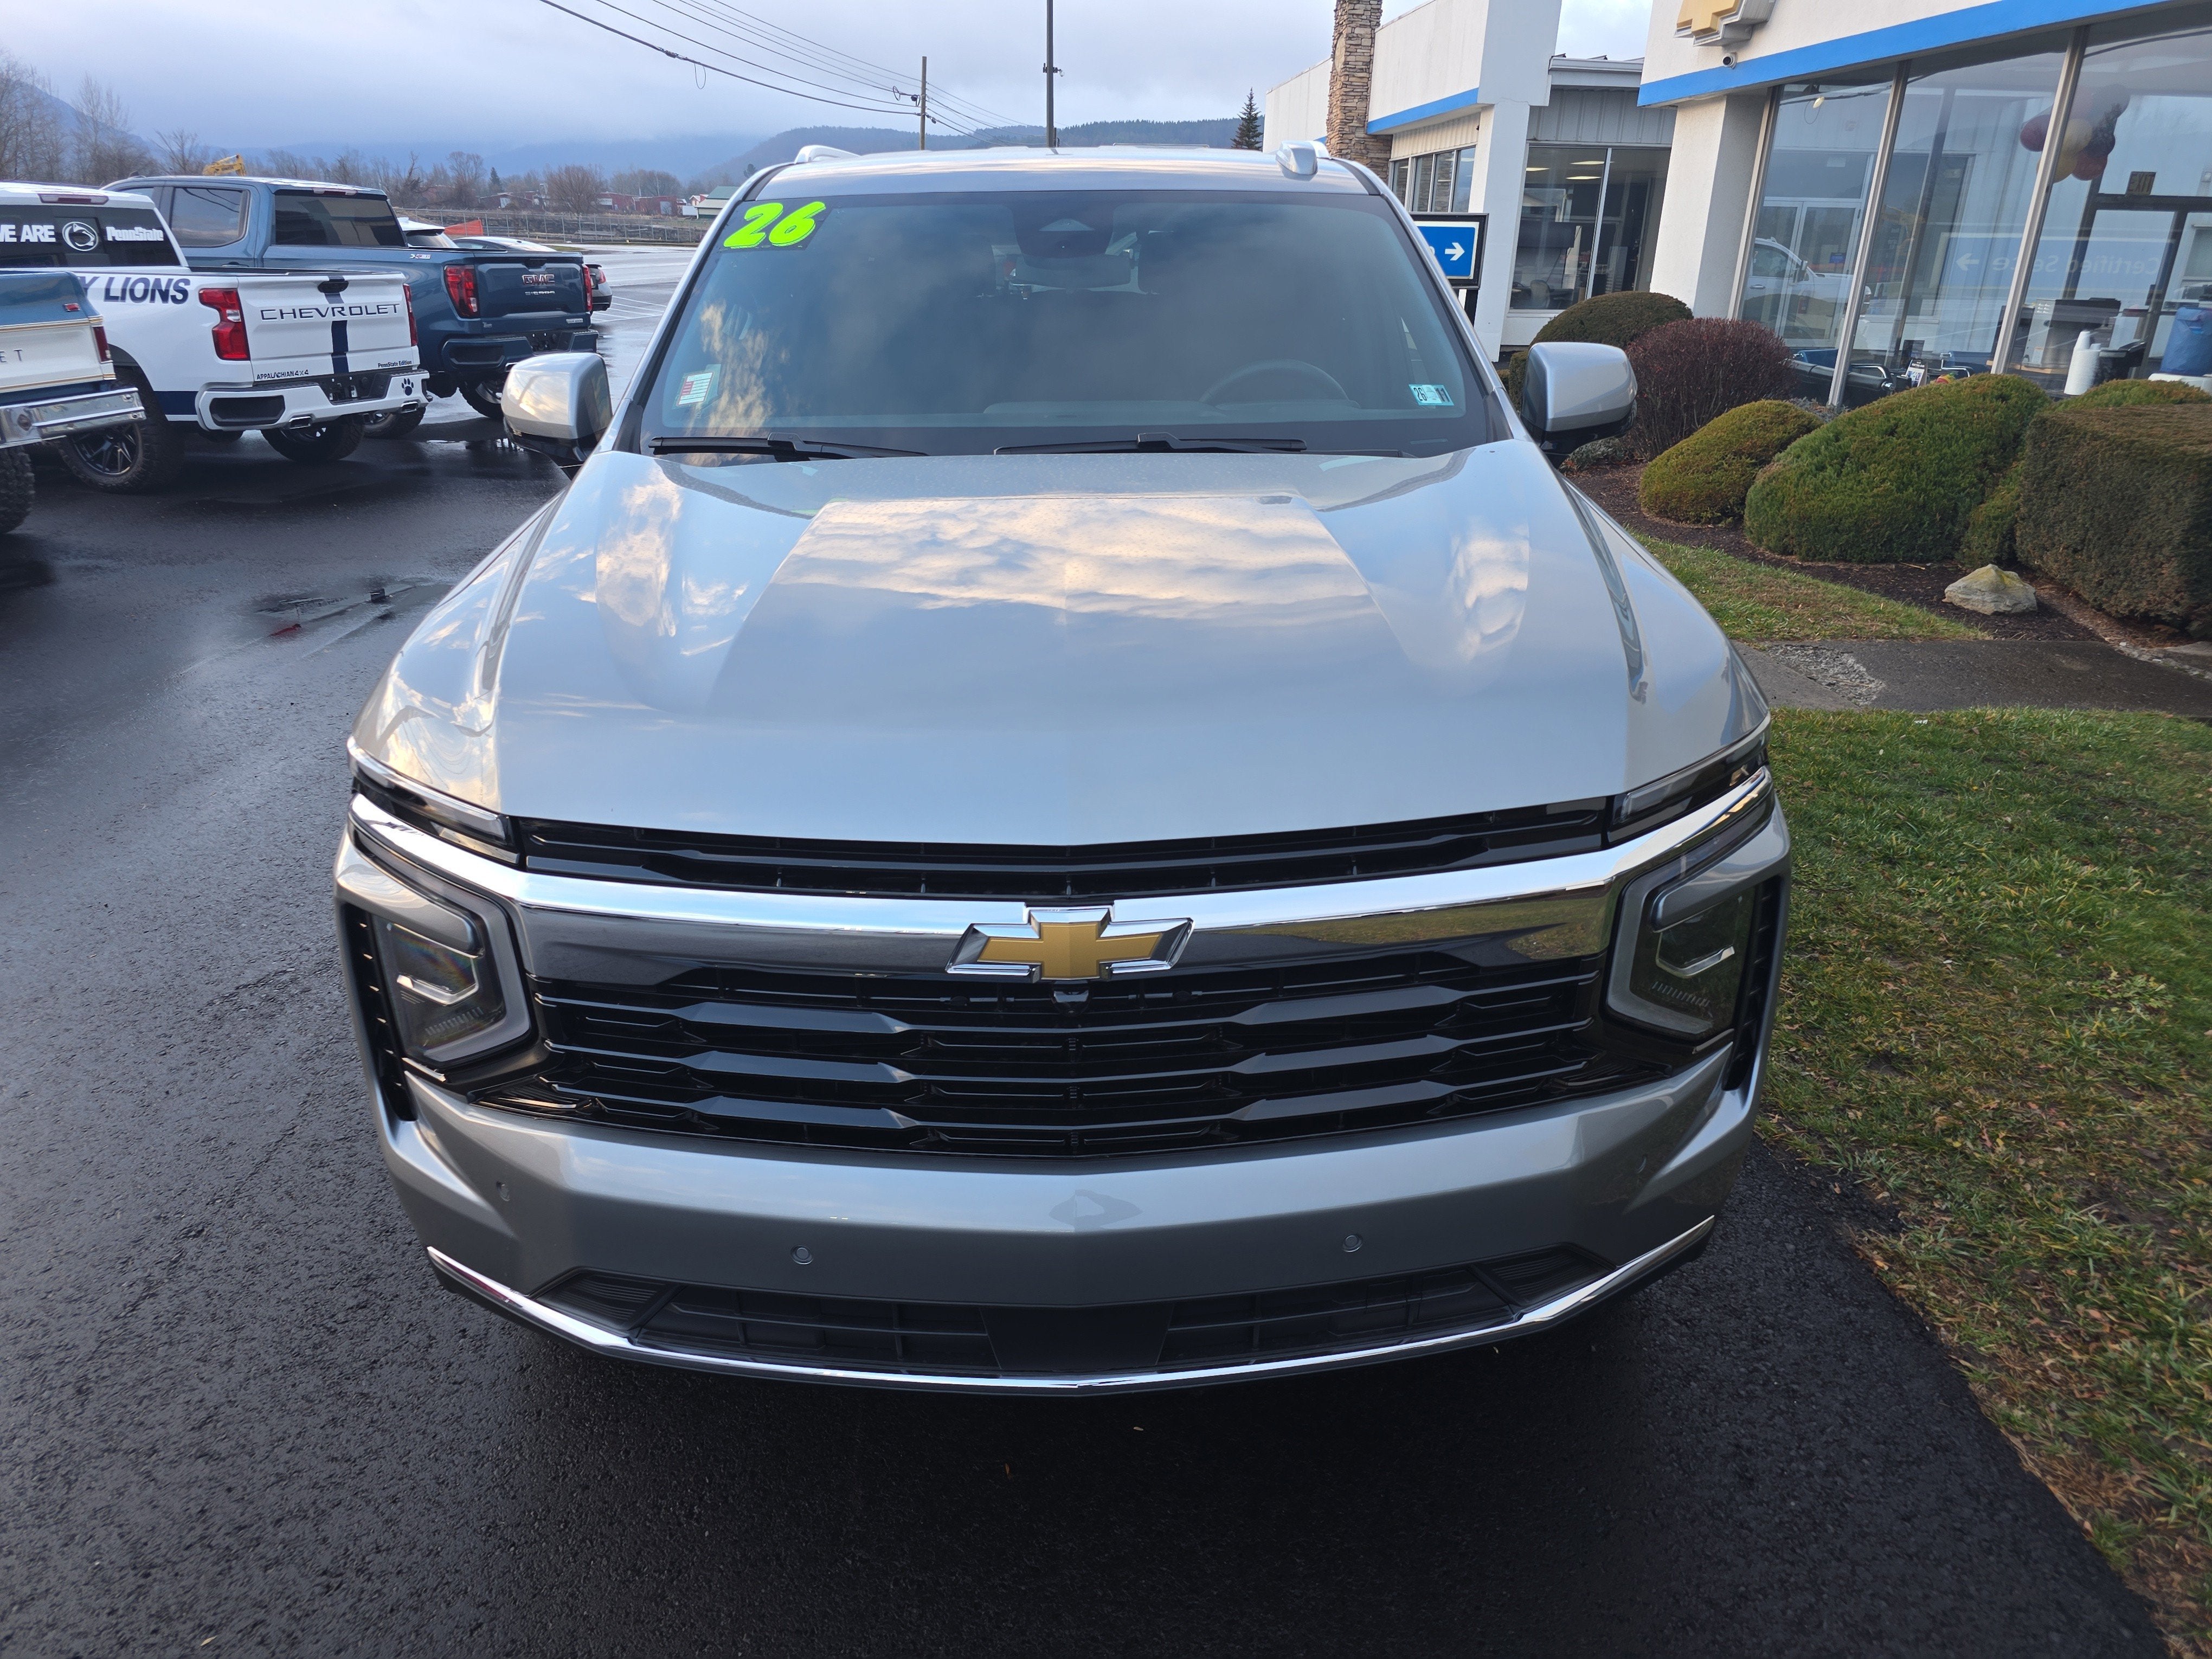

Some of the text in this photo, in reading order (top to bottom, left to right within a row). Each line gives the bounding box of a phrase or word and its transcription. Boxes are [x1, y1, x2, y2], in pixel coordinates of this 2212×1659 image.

[0, 224, 56, 242] E ARE
[724, 201, 826, 249] 26
[106, 226, 164, 241] PennState
[522, 274, 555, 286] GMC
[103, 276, 191, 305] LIONS
[260, 304, 400, 320] CHEVROLET
[1413, 387, 1427, 401] 26
